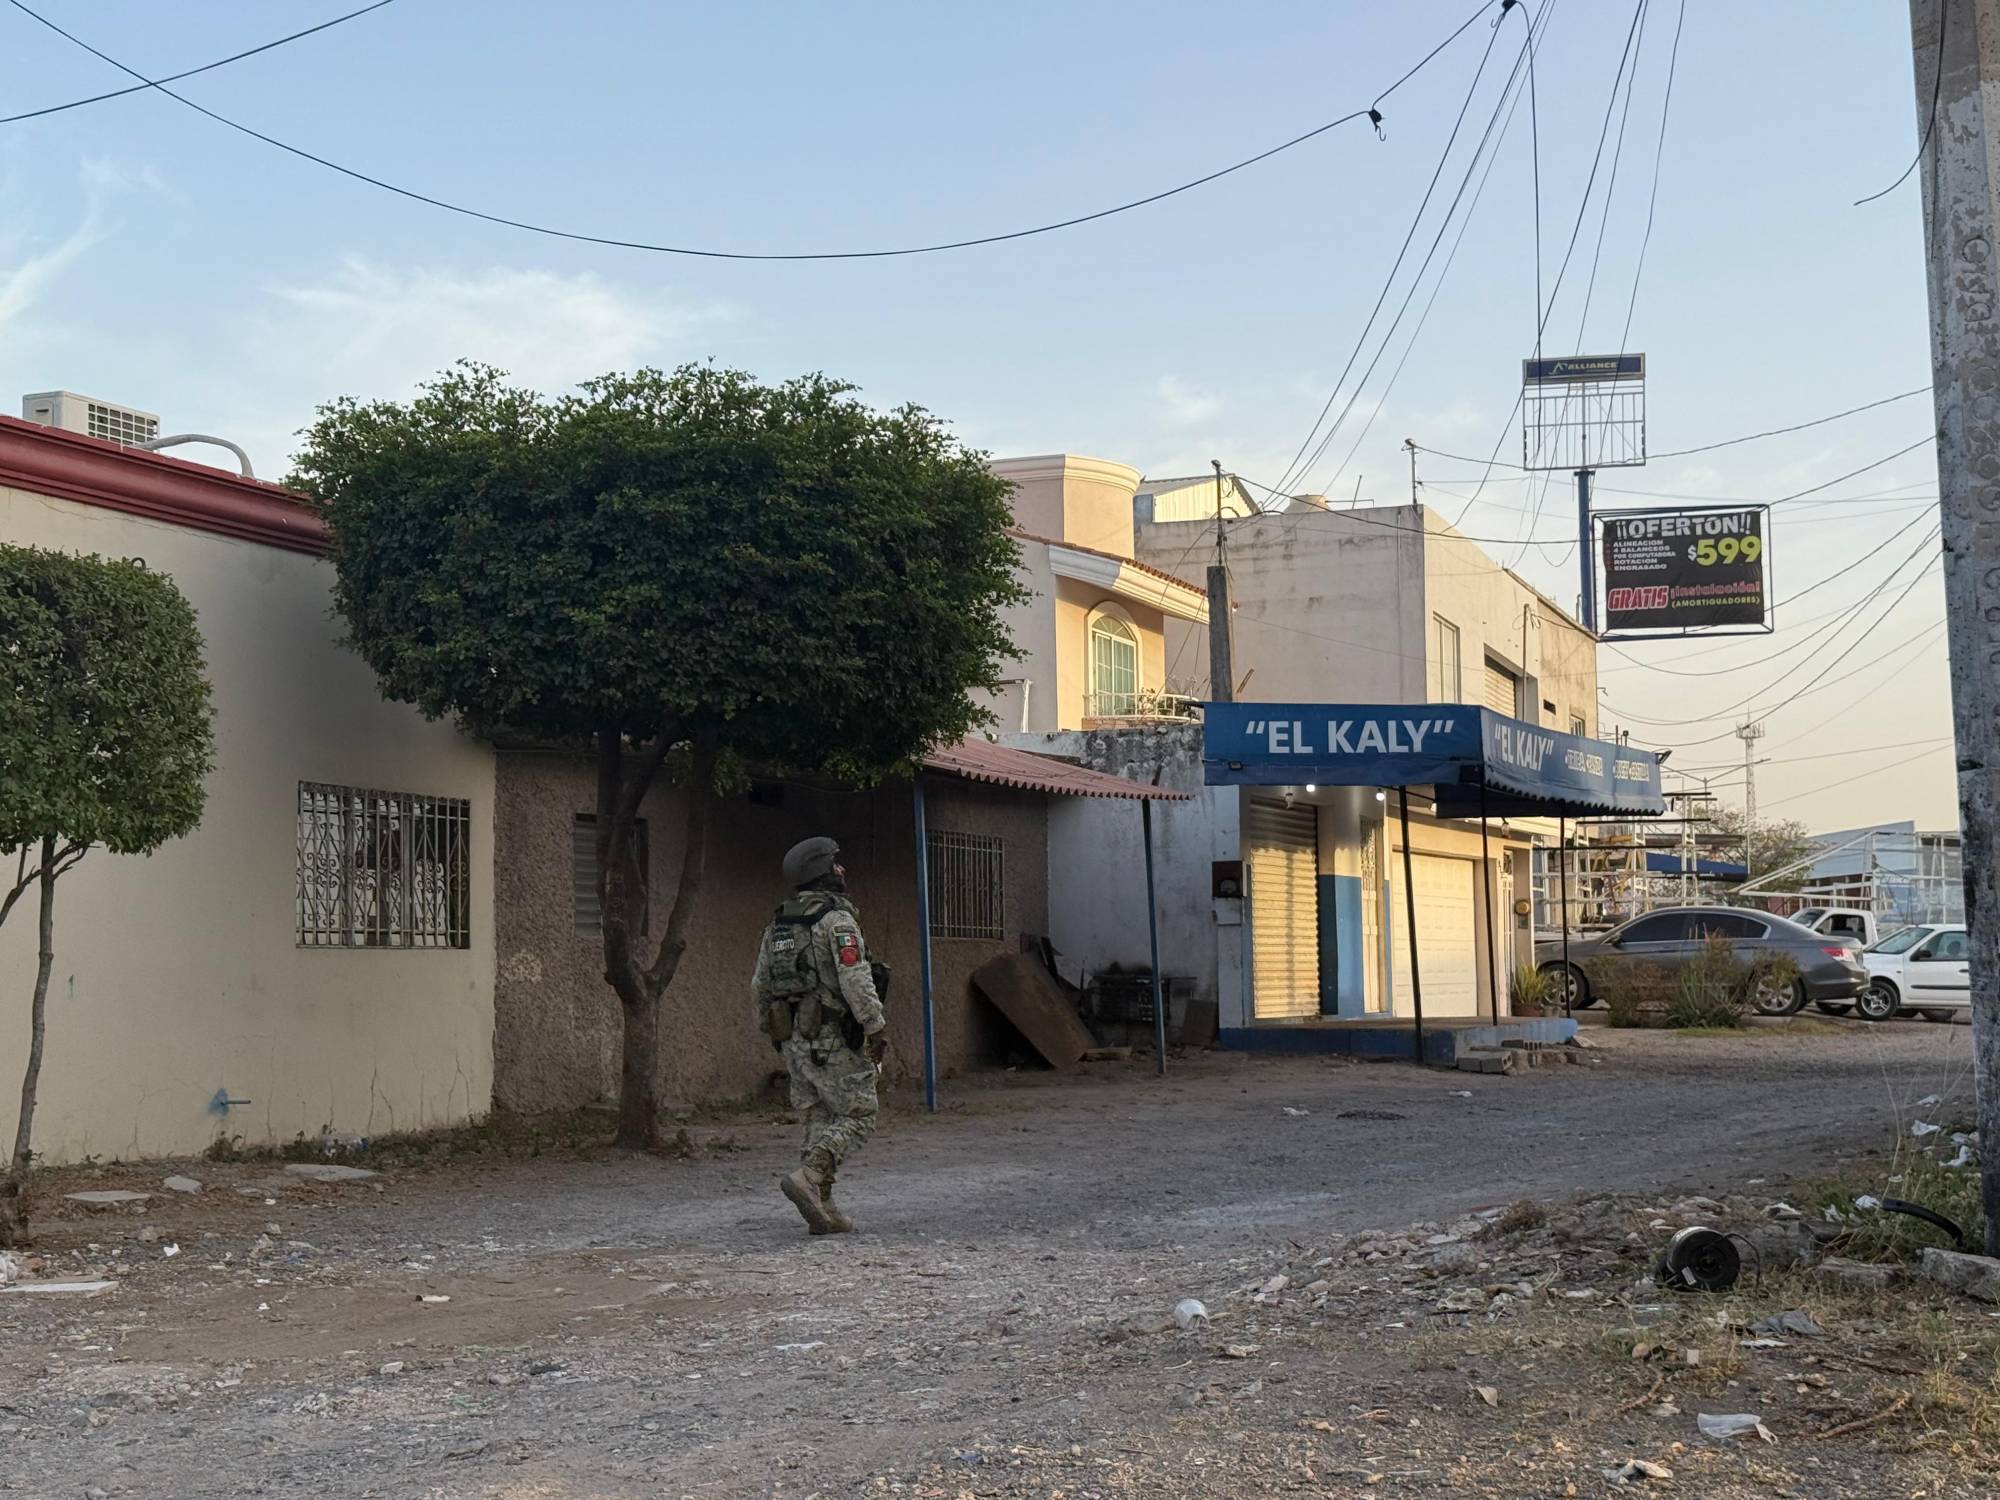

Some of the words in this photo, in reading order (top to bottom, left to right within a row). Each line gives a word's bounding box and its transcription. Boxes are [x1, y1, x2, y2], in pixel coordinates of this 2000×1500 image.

[1568, 361, 1617, 370] ALLIANCE
[1687, 535, 1761, 566] $599
[1607, 586, 1669, 611] GRATIS
